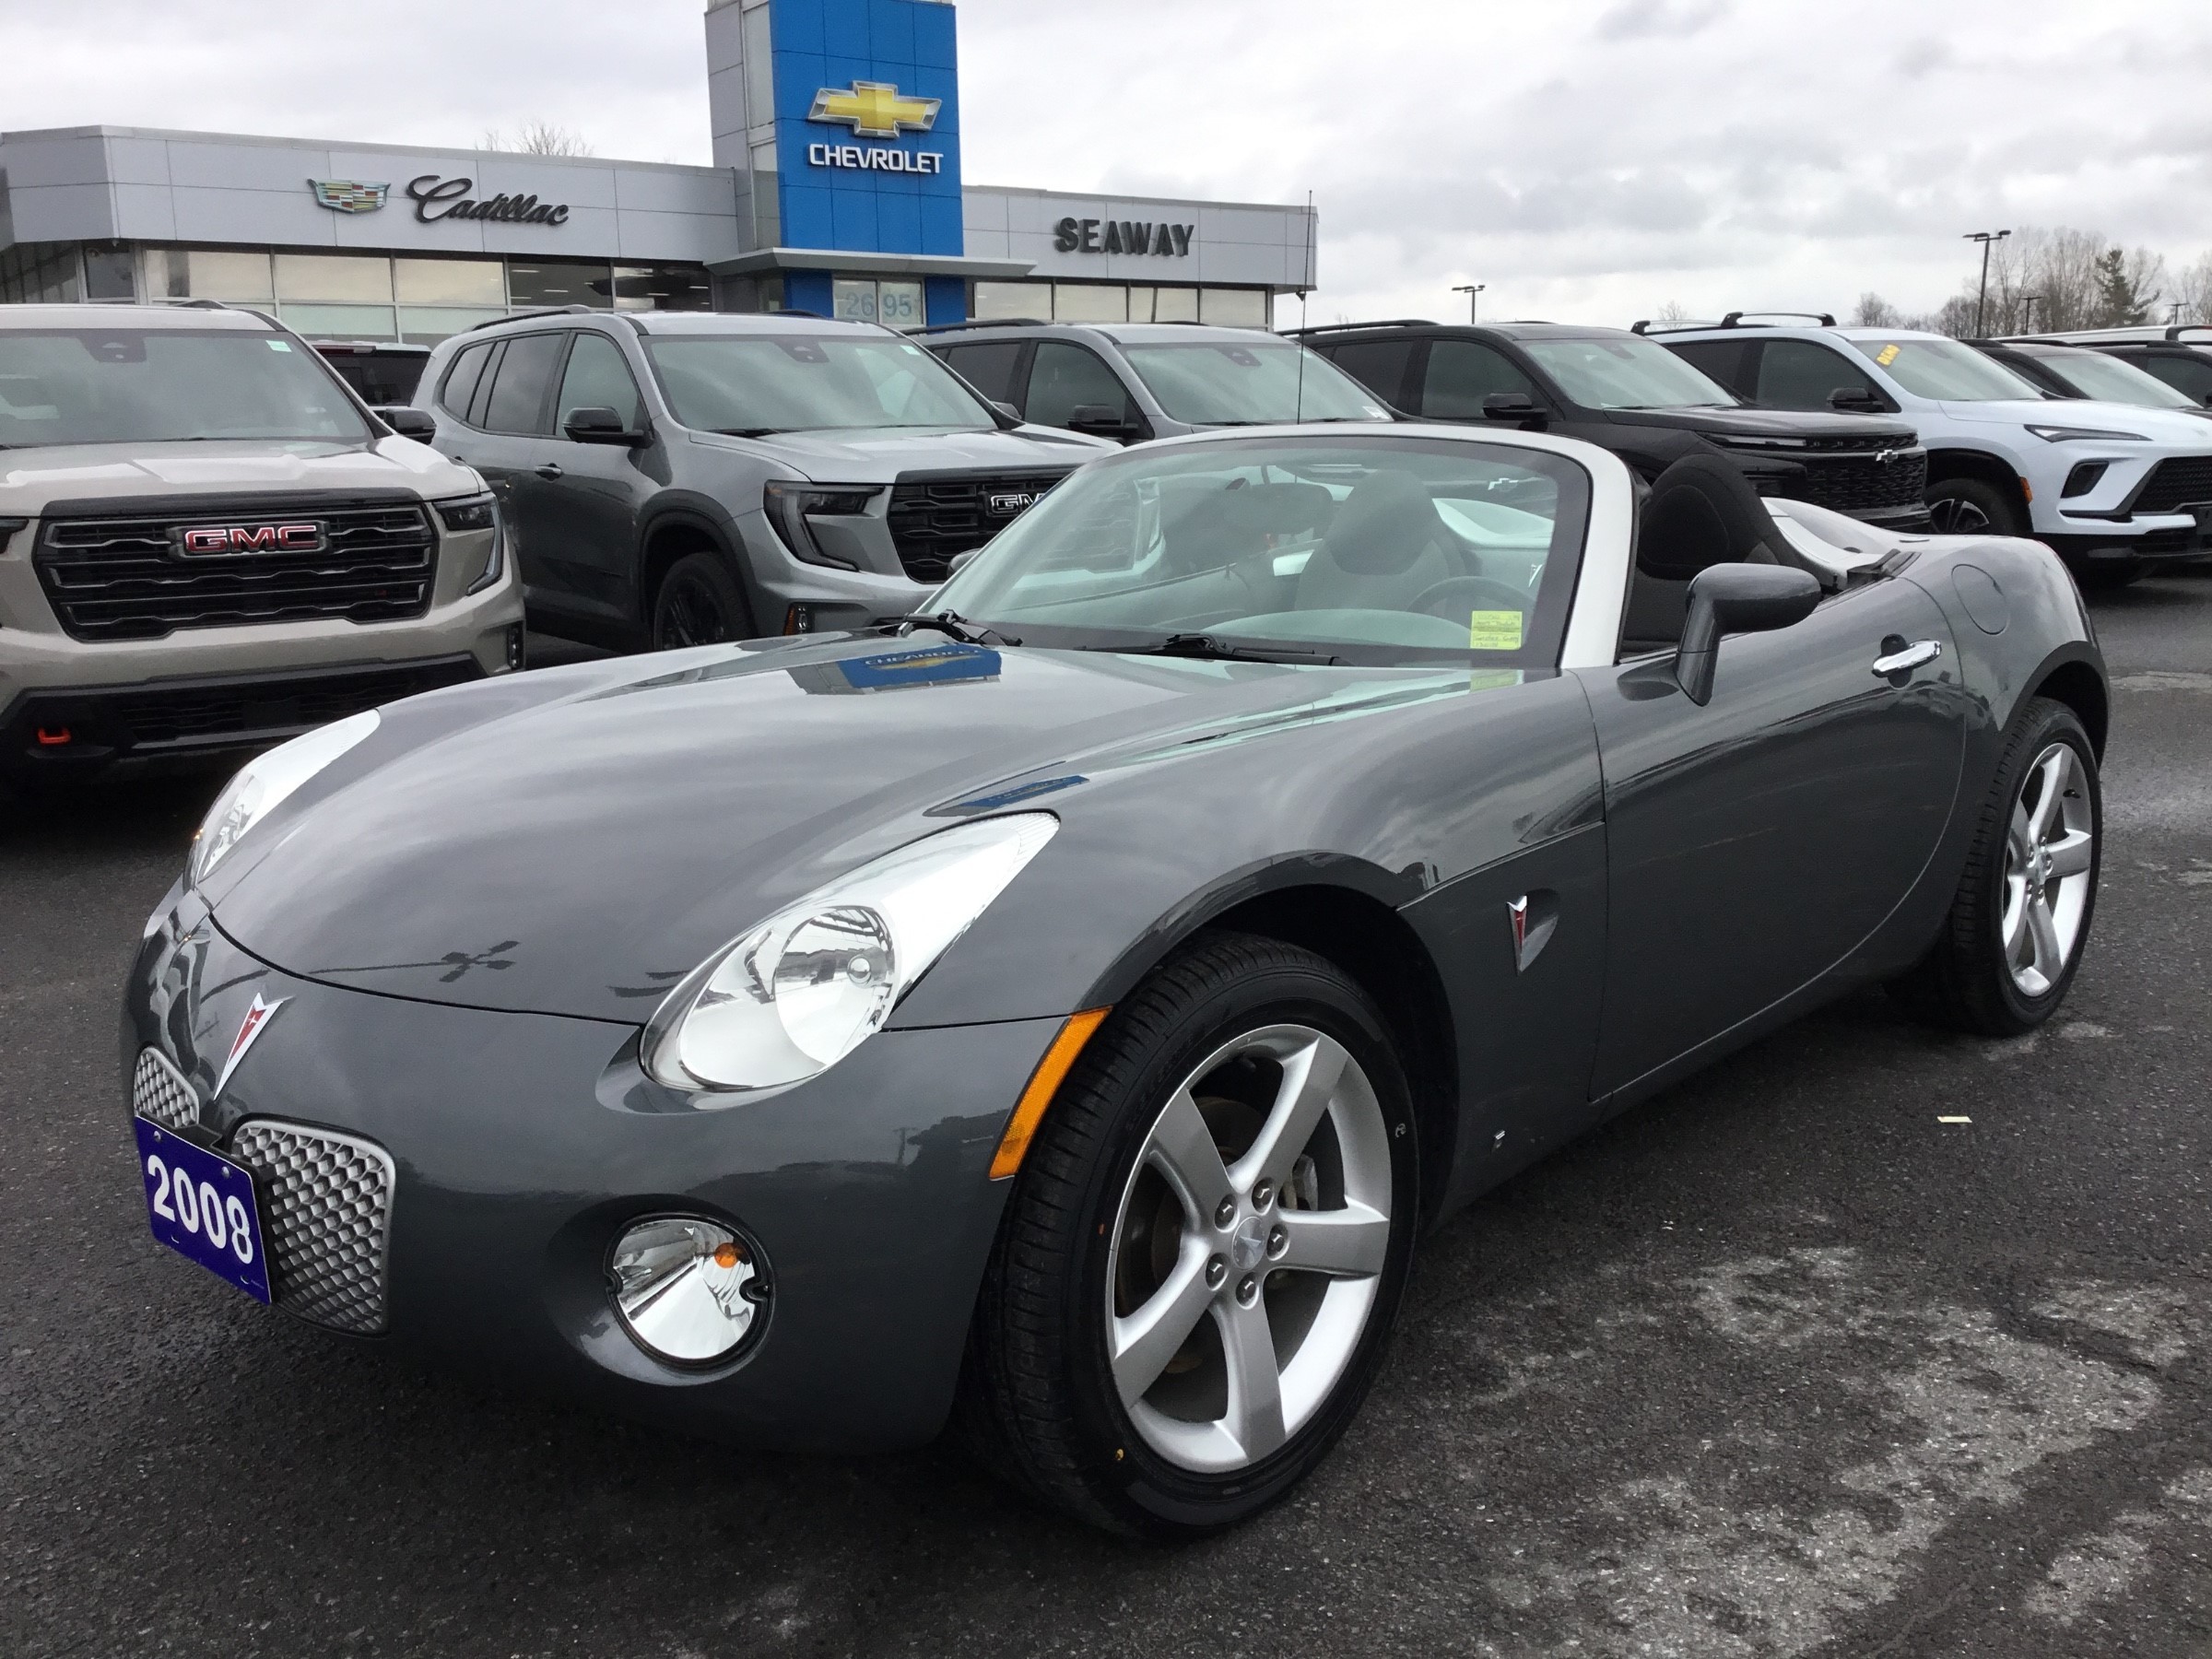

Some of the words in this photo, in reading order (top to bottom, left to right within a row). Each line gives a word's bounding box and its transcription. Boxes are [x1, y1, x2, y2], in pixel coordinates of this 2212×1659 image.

[808, 142, 944, 174] CHEVROLET
[406, 175, 569, 225] Cadillac
[1054, 217, 1194, 256] SEAWAY
[845, 292, 875, 316] 26
[882, 293, 912, 317] 95
[990, 493, 1046, 513] GM
[184, 524, 318, 553] GMC
[147, 1155, 253, 1265] 2008
